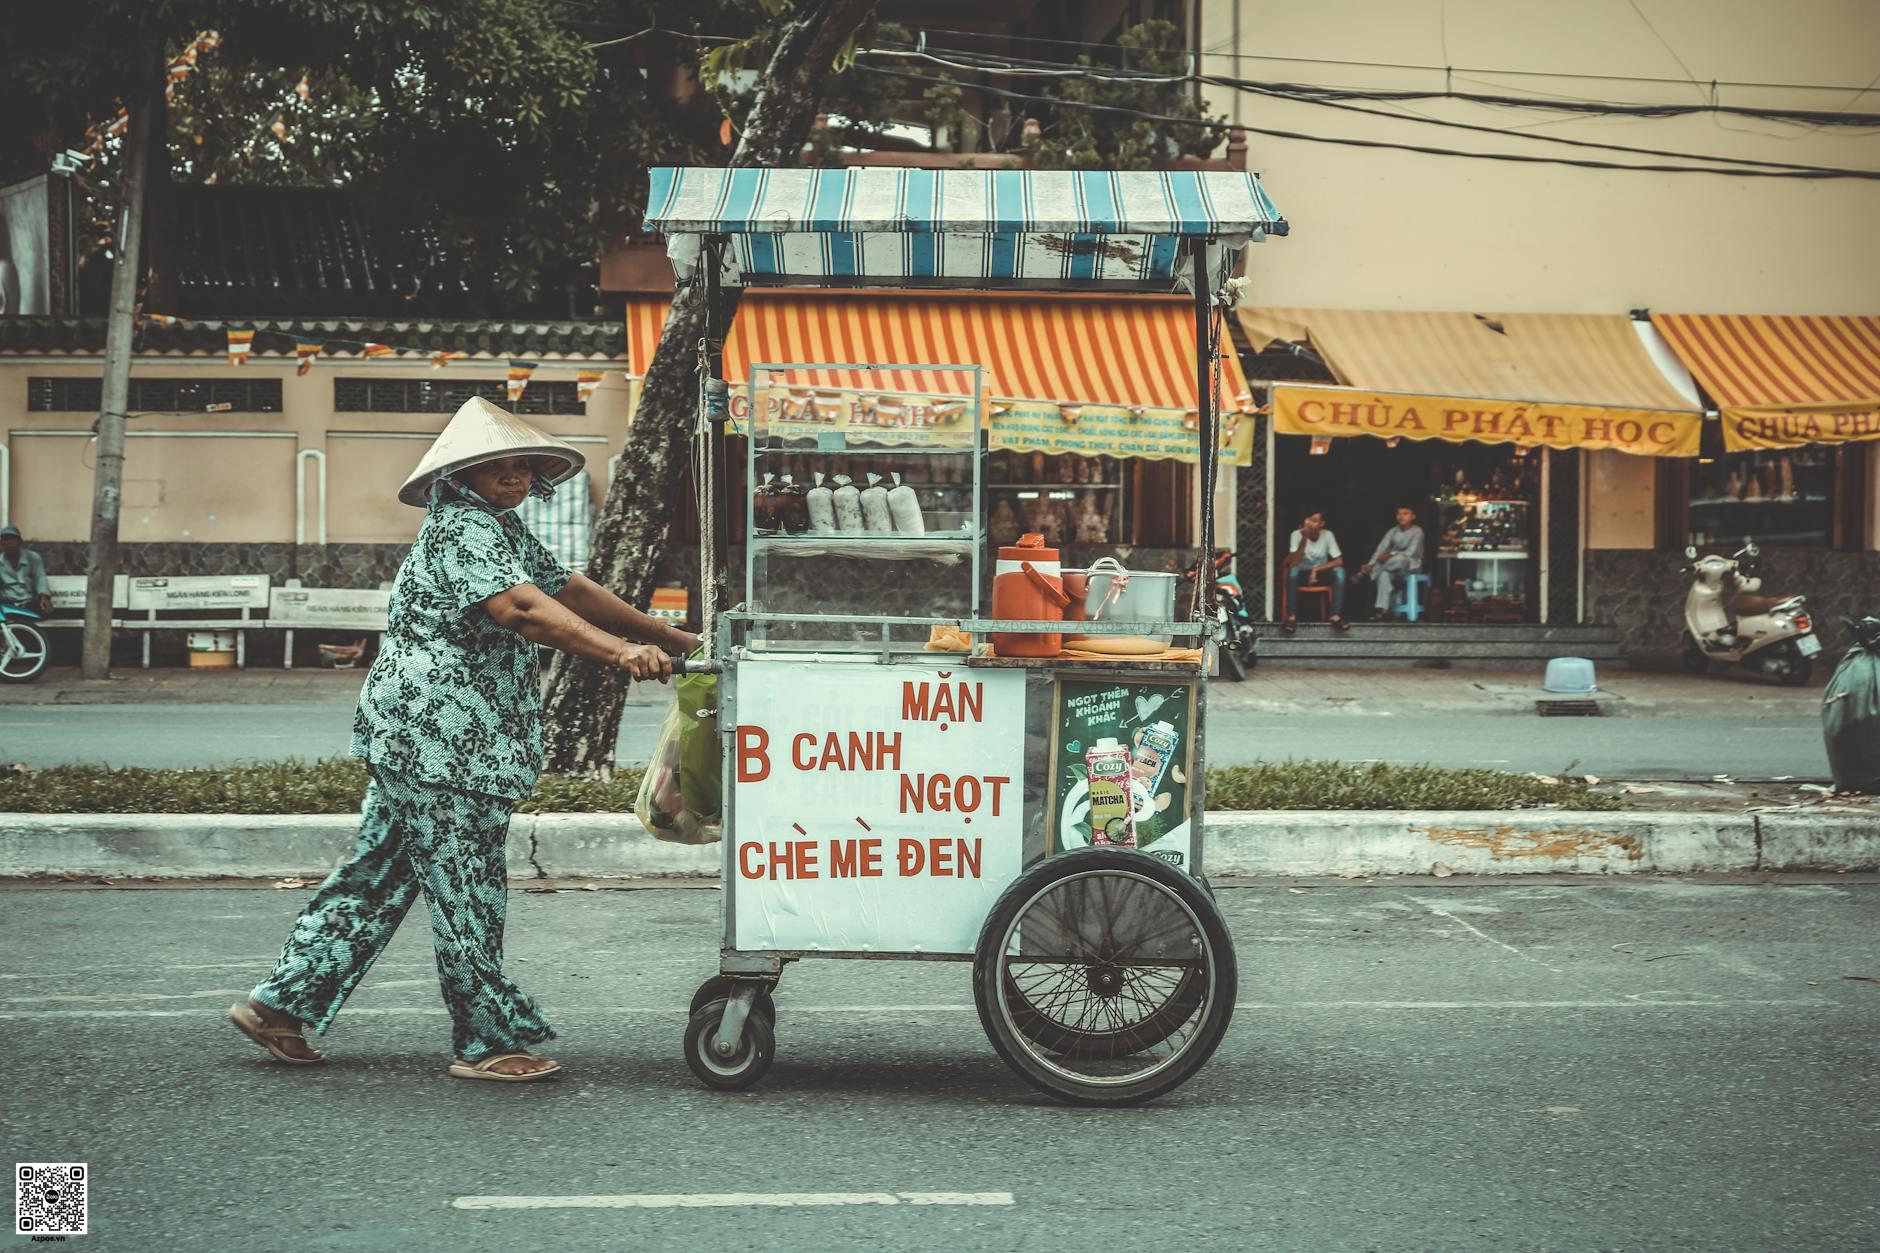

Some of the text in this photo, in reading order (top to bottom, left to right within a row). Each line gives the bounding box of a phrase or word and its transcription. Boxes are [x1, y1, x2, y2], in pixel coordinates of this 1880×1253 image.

[1297, 398, 1676, 448] CHÙA PHẬT HỌC
[902, 671, 983, 732] MẶN
[1100, 686, 1129, 701] THÊM
[736, 725, 902, 783] B CANH
[1095, 761, 1123, 773] Cozy
[900, 773, 1010, 824] NGỌT
[1092, 794, 1124, 806] MATCHA
[739, 816, 982, 881] CHÈ MÈ ĐEN
